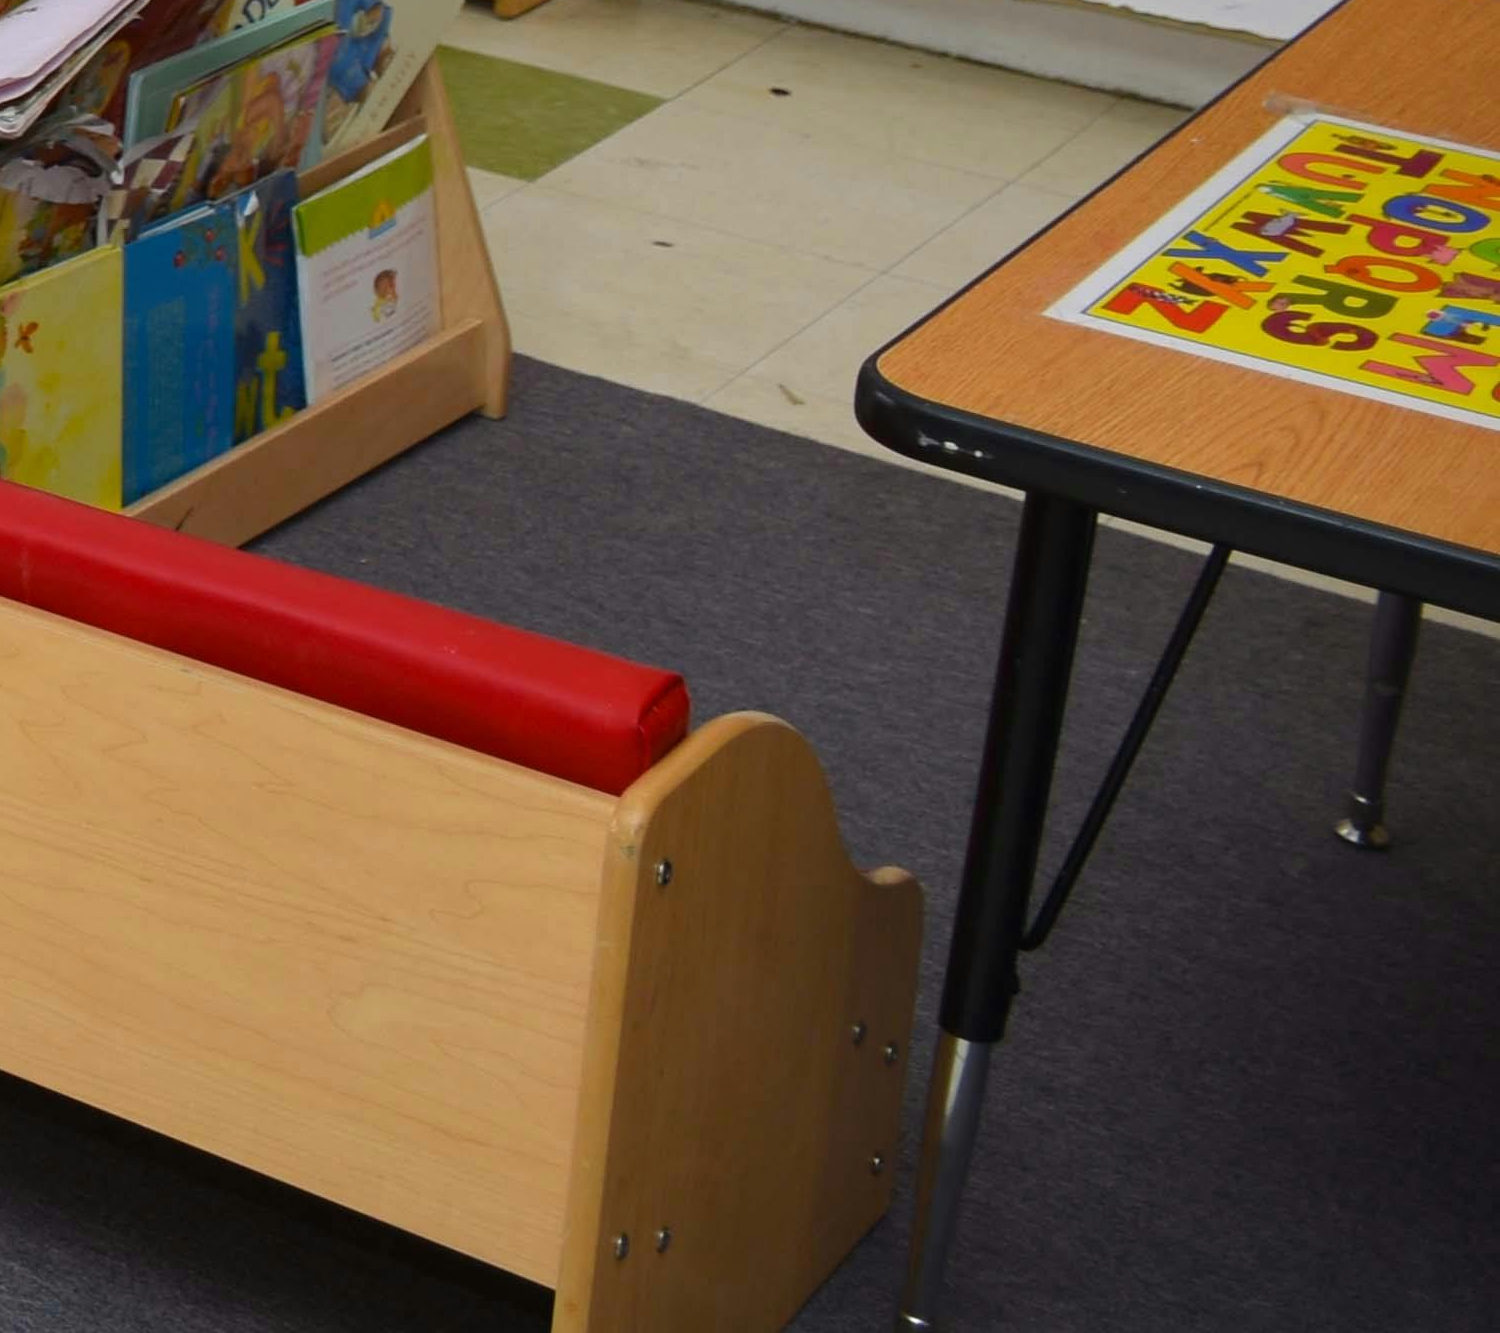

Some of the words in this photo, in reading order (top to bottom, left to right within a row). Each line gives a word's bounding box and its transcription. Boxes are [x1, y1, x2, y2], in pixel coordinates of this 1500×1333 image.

[1277, 151, 1388, 191] U
[1334, 143, 1446, 179] T
[1256, 183, 1366, 218] V
[1381, 193, 1491, 234] O
[1161, 230, 1291, 278] X
[1229, 211, 1353, 258] W
[1344, 213, 1450, 258] P
[1167, 261, 1276, 310] Y
[1323, 255, 1444, 293] Q
[1101, 282, 1230, 334] Z
[1274, 275, 1400, 319] R
[1260, 310, 1379, 352] S
